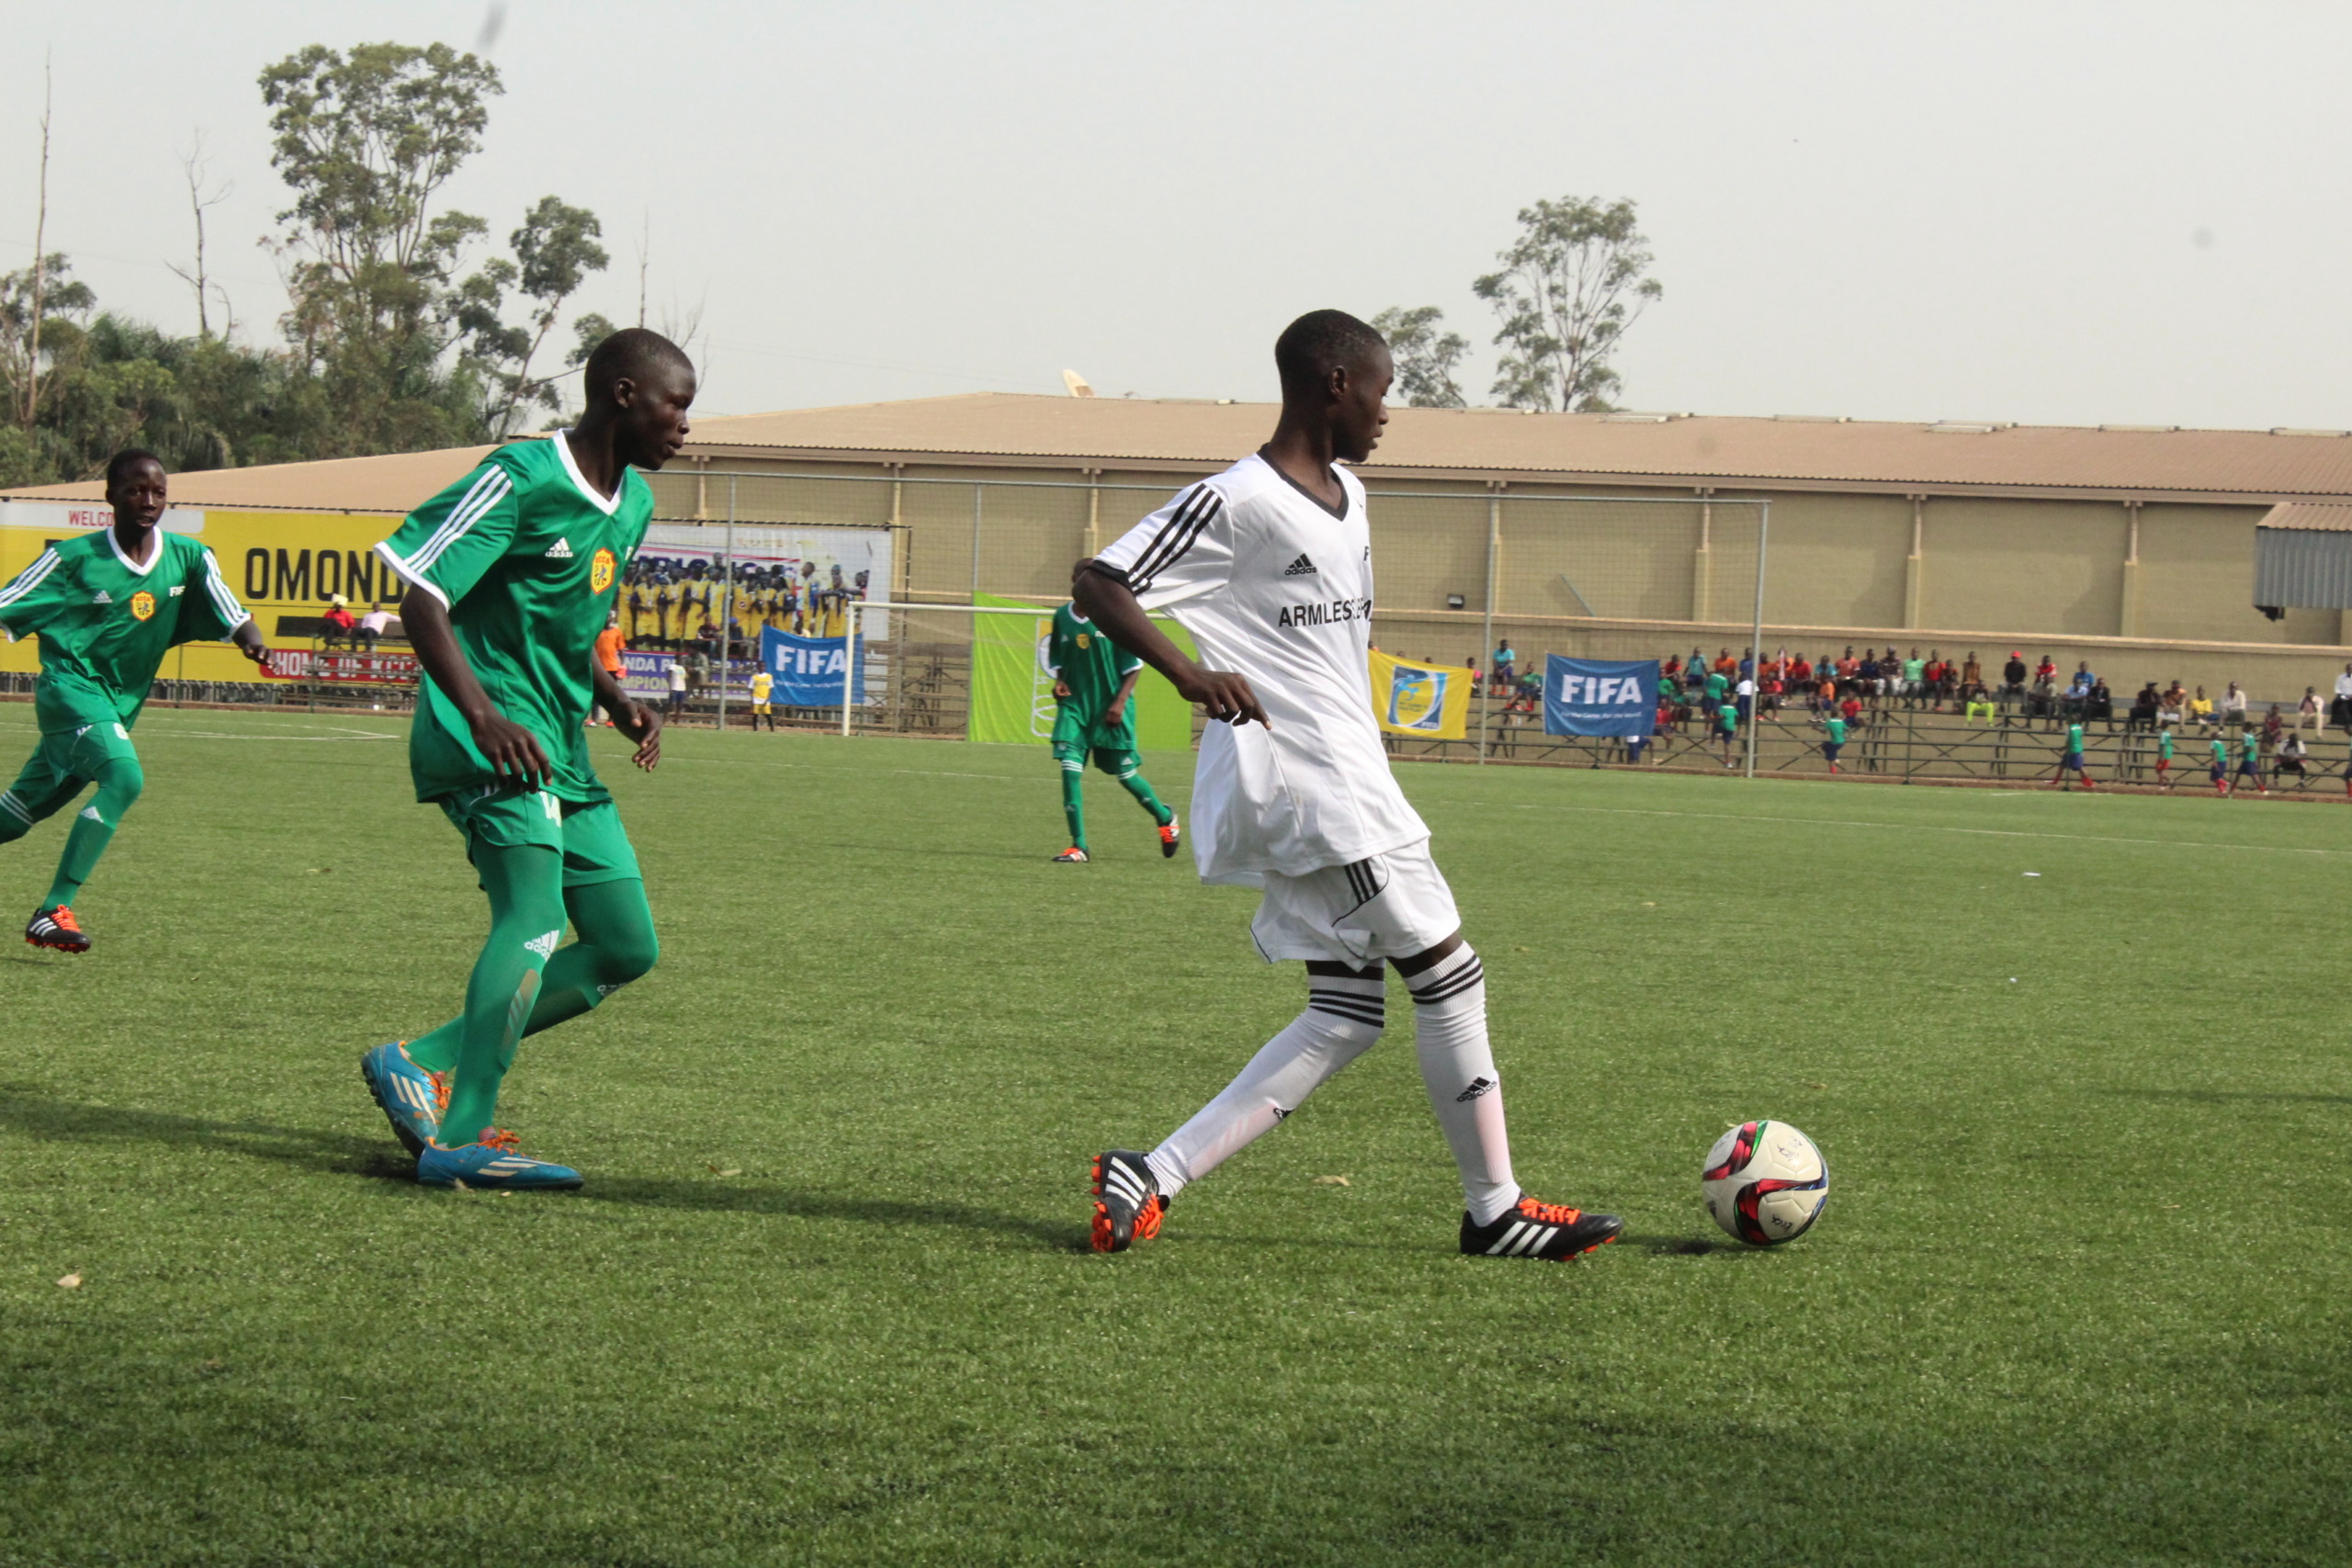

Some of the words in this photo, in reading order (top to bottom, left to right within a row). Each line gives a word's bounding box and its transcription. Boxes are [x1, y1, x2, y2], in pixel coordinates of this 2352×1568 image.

[69, 511, 114, 527] WELCO
[245, 547, 404, 604] OMOND
[1284, 567, 1317, 576] adidas
[169, 586, 186, 597] FIF
[370, 655, 424, 681] KCC
[623, 656, 658, 673] NDA
[775, 645, 848, 675] FIFA
[1561, 674, 1643, 705] FIFA
[1456, 1080, 1498, 1102] adidas
